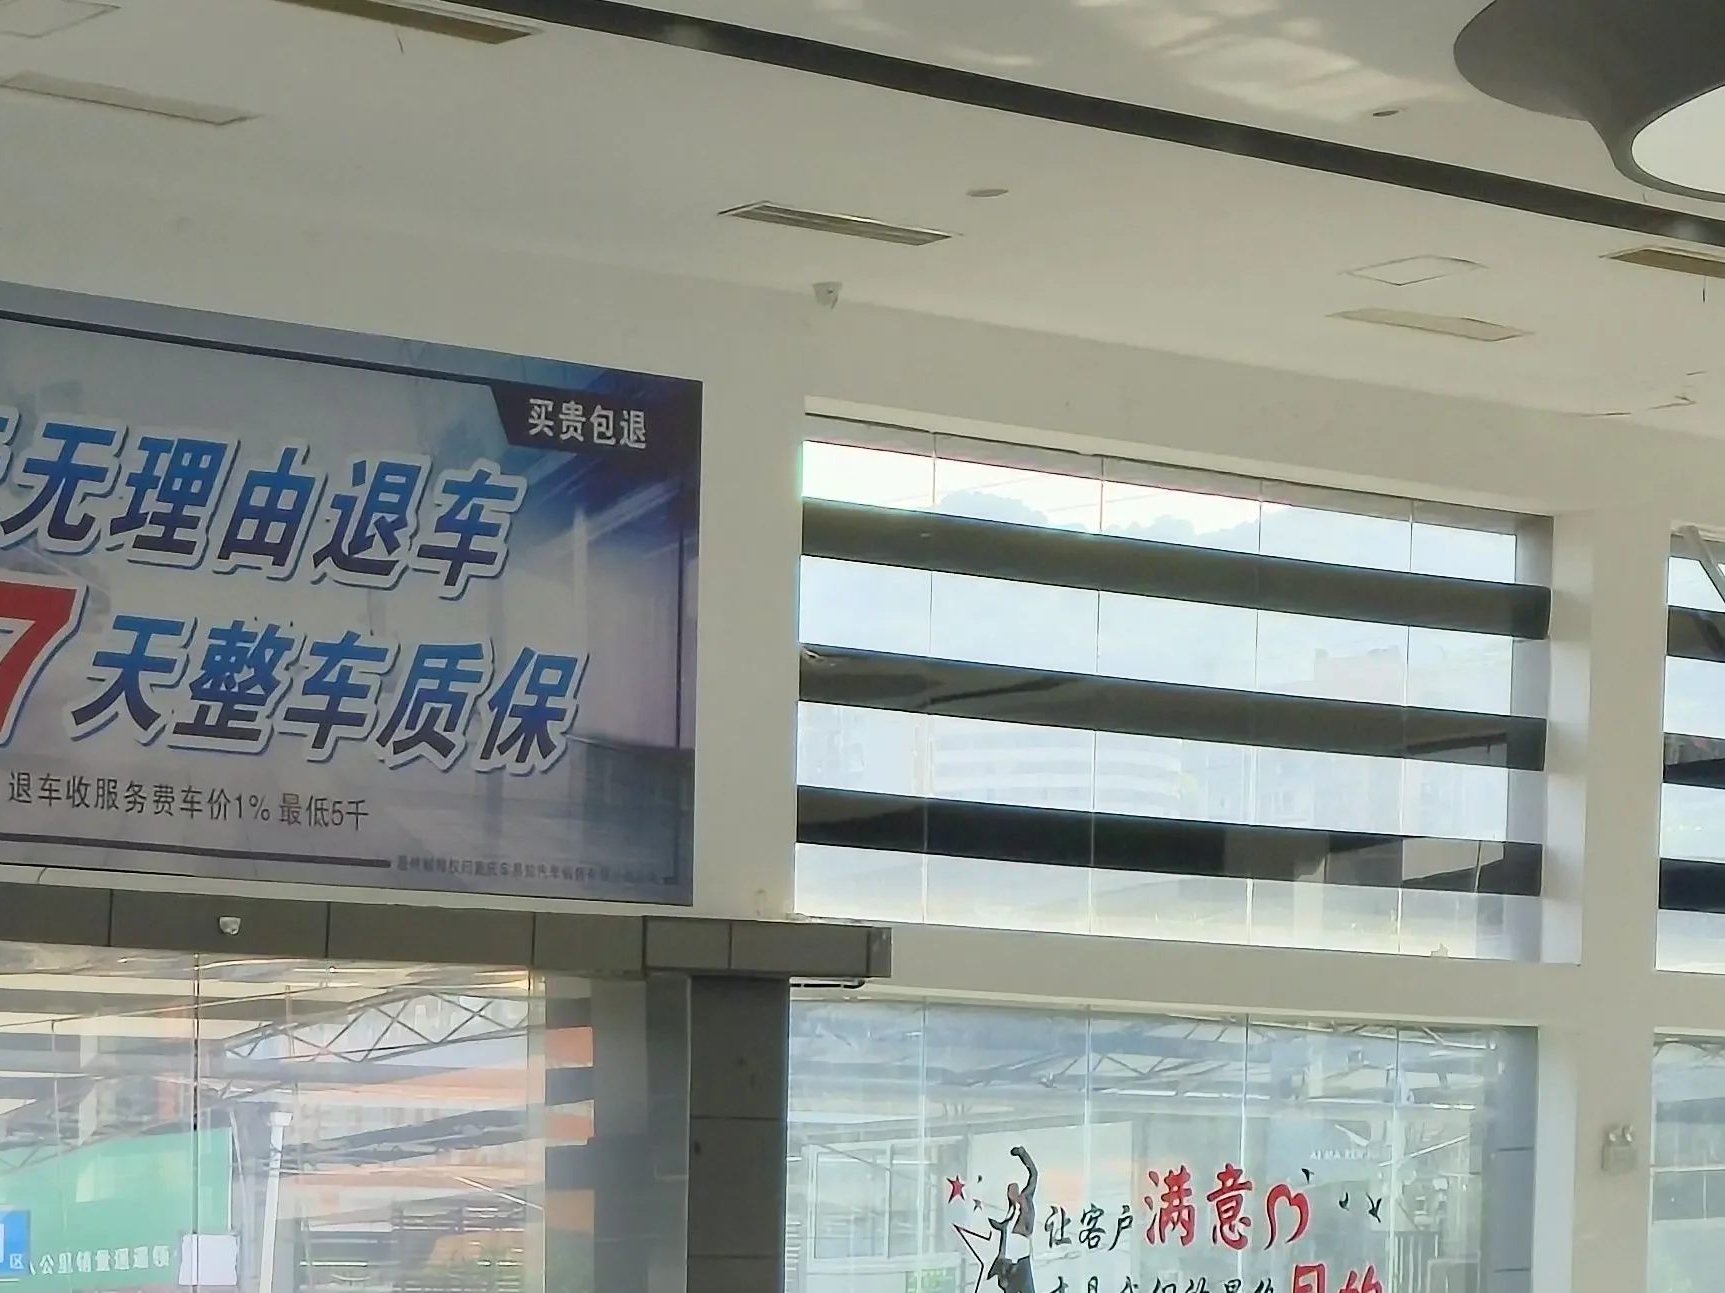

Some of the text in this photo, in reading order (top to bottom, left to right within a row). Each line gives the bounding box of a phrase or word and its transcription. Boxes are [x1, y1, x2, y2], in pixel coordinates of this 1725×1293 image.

[527, 398, 647, 452] 买贵包退
[1043, 1162, 1254, 1251] 让客户满意
